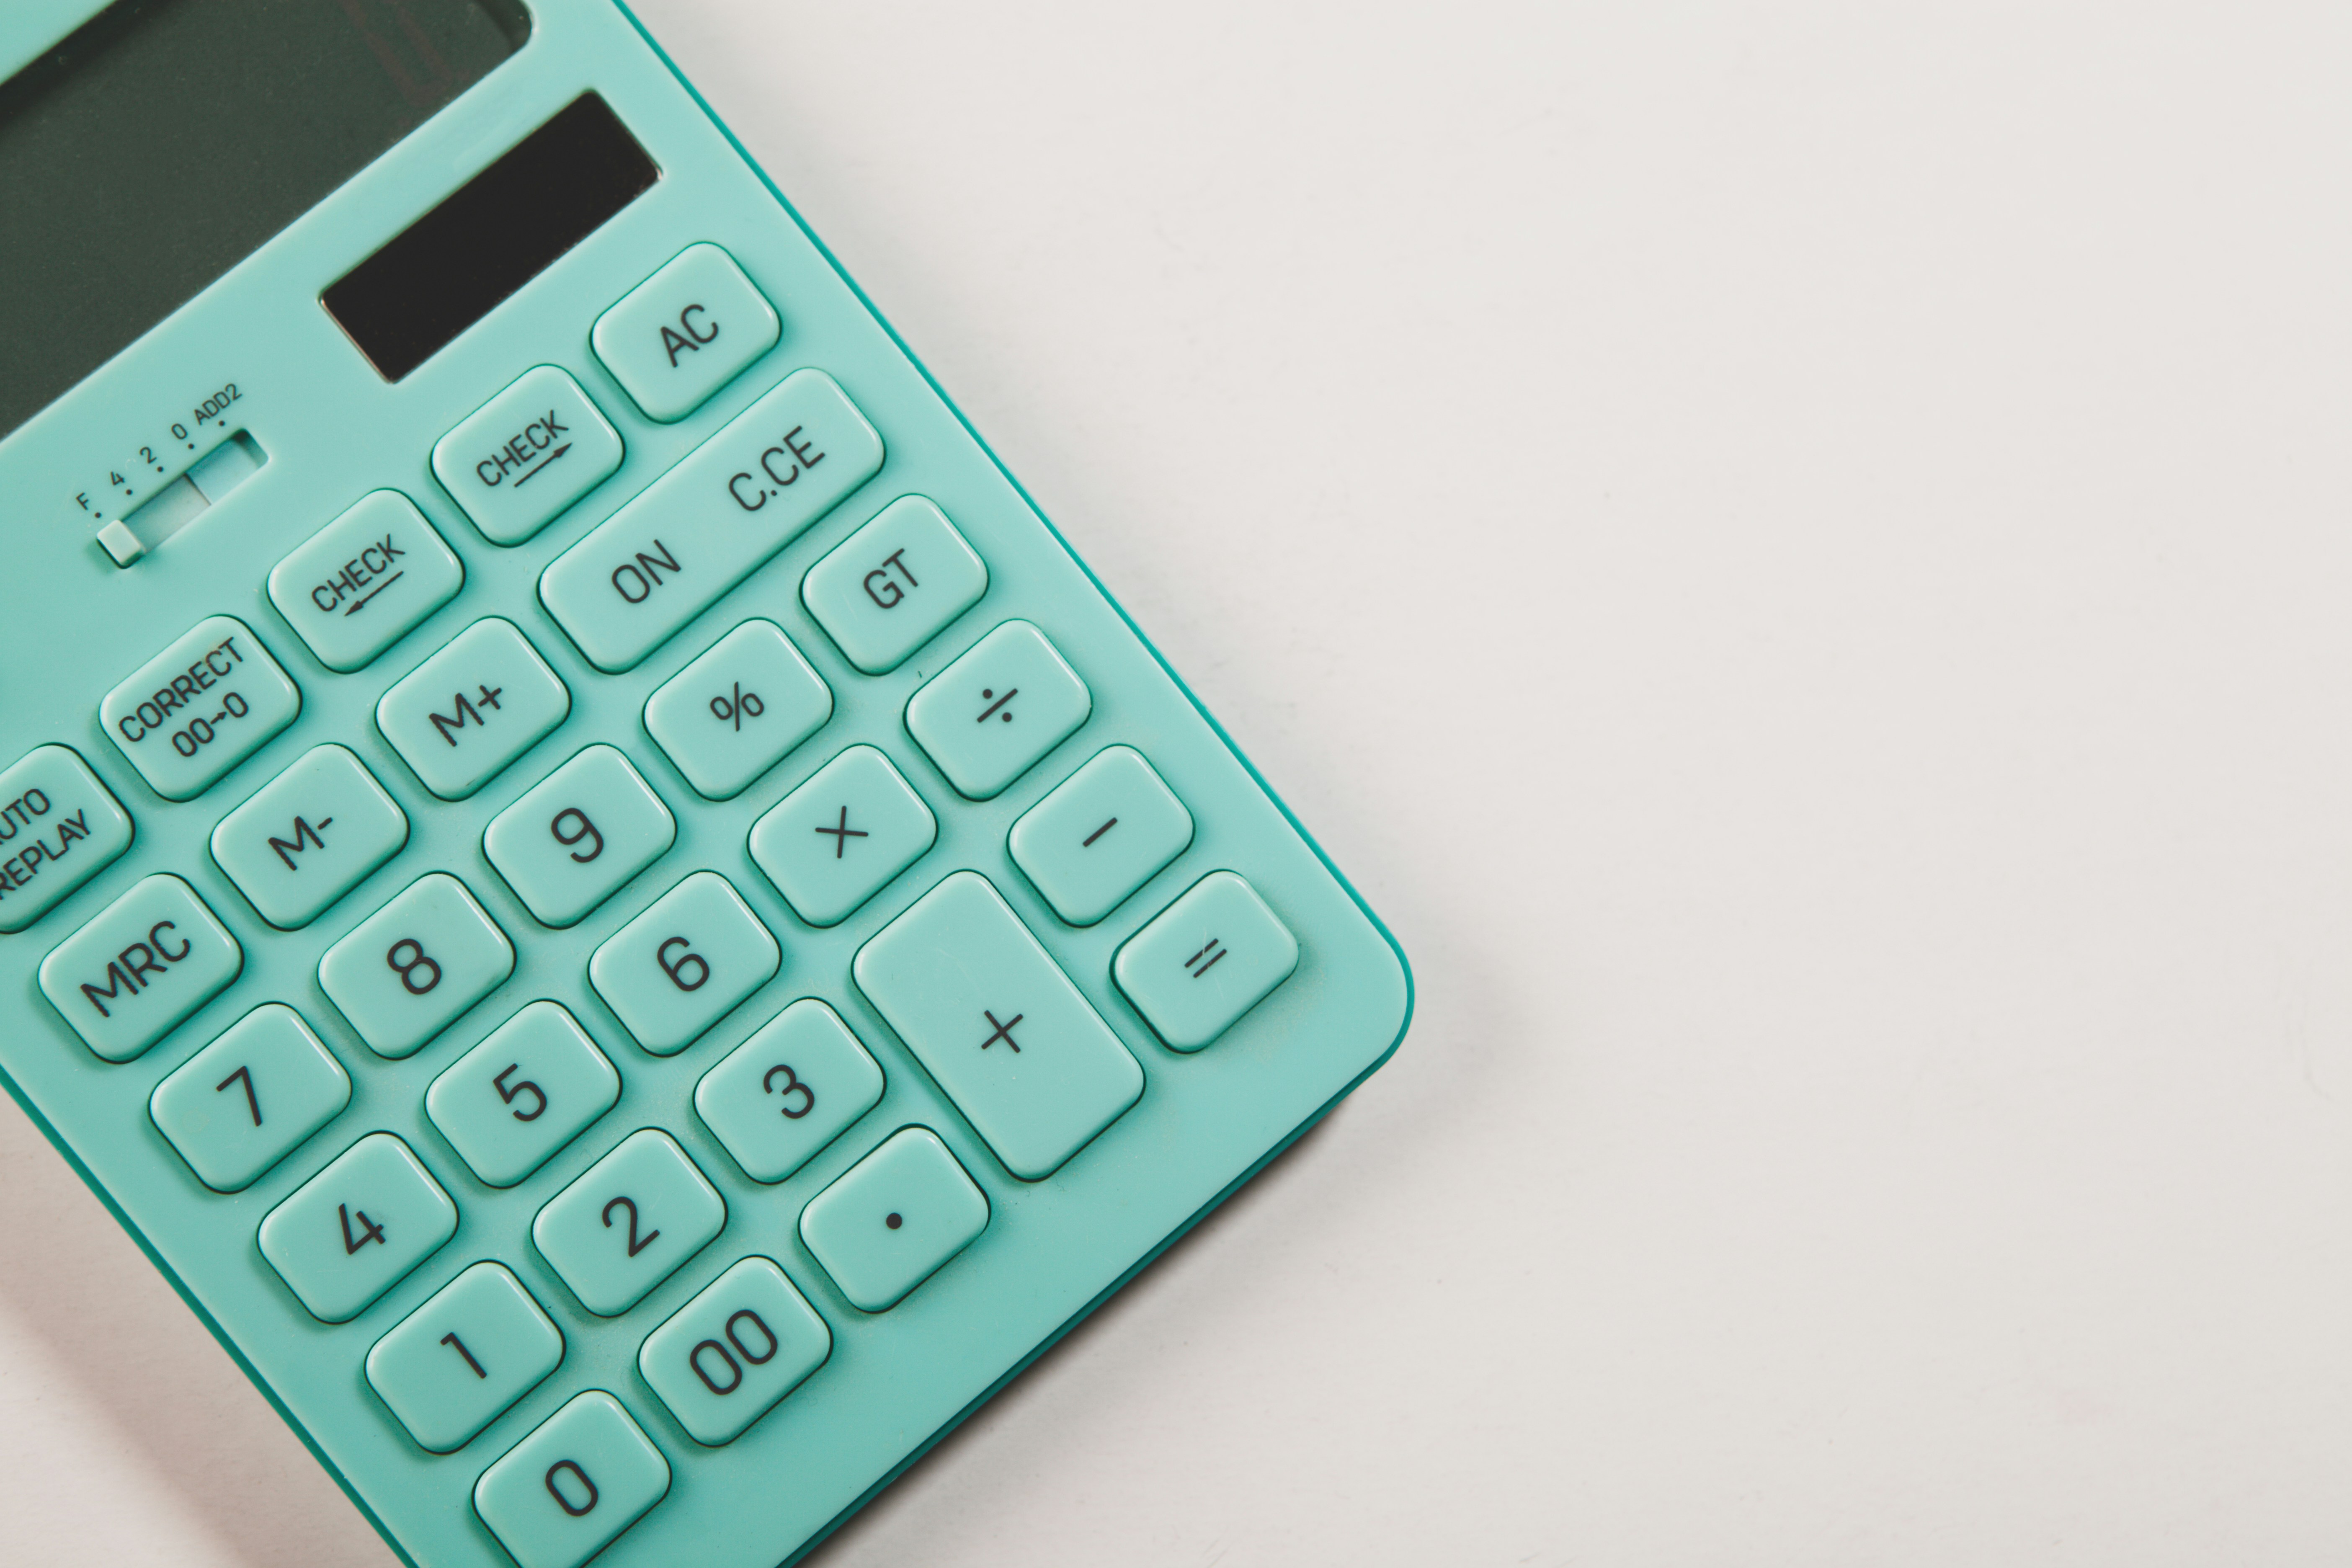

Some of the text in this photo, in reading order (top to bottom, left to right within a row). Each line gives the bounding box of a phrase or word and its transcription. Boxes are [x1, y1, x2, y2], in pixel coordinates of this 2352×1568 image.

[660, 303, 720, 369] AC
[75, 383, 242, 511] F 4 2 0 ADD2
[476, 409, 570, 487] CHECK
[611, 425, 826, 605] ON C.CE
[311, 533, 406, 613] CHECK
[862, 547, 919, 610] GT
[118, 636, 244, 743] CORRECT
[428, 684, 503, 748] M+
[709, 681, 765, 732] %
[0, 787, 51, 846] UTO
[267, 815, 333, 872] M-
[550, 807, 605, 864] 9
[79, 920, 191, 1019] MRC
[386, 937, 443, 996] 8
[656, 935, 711, 993] 6
[1184, 937, 1228, 979] =
[980, 1009, 1024, 1054] +
[215, 1065, 263, 1128] 7
[492, 1062, 548, 1123] 5
[762, 1063, 816, 1120] 3
[338, 1202, 387, 1256] 4
[601, 1195, 661, 1259] 2
[439, 1331, 488, 1380] 1
[689, 1308, 779, 1397] 00
[544, 1458, 600, 1518] 0
